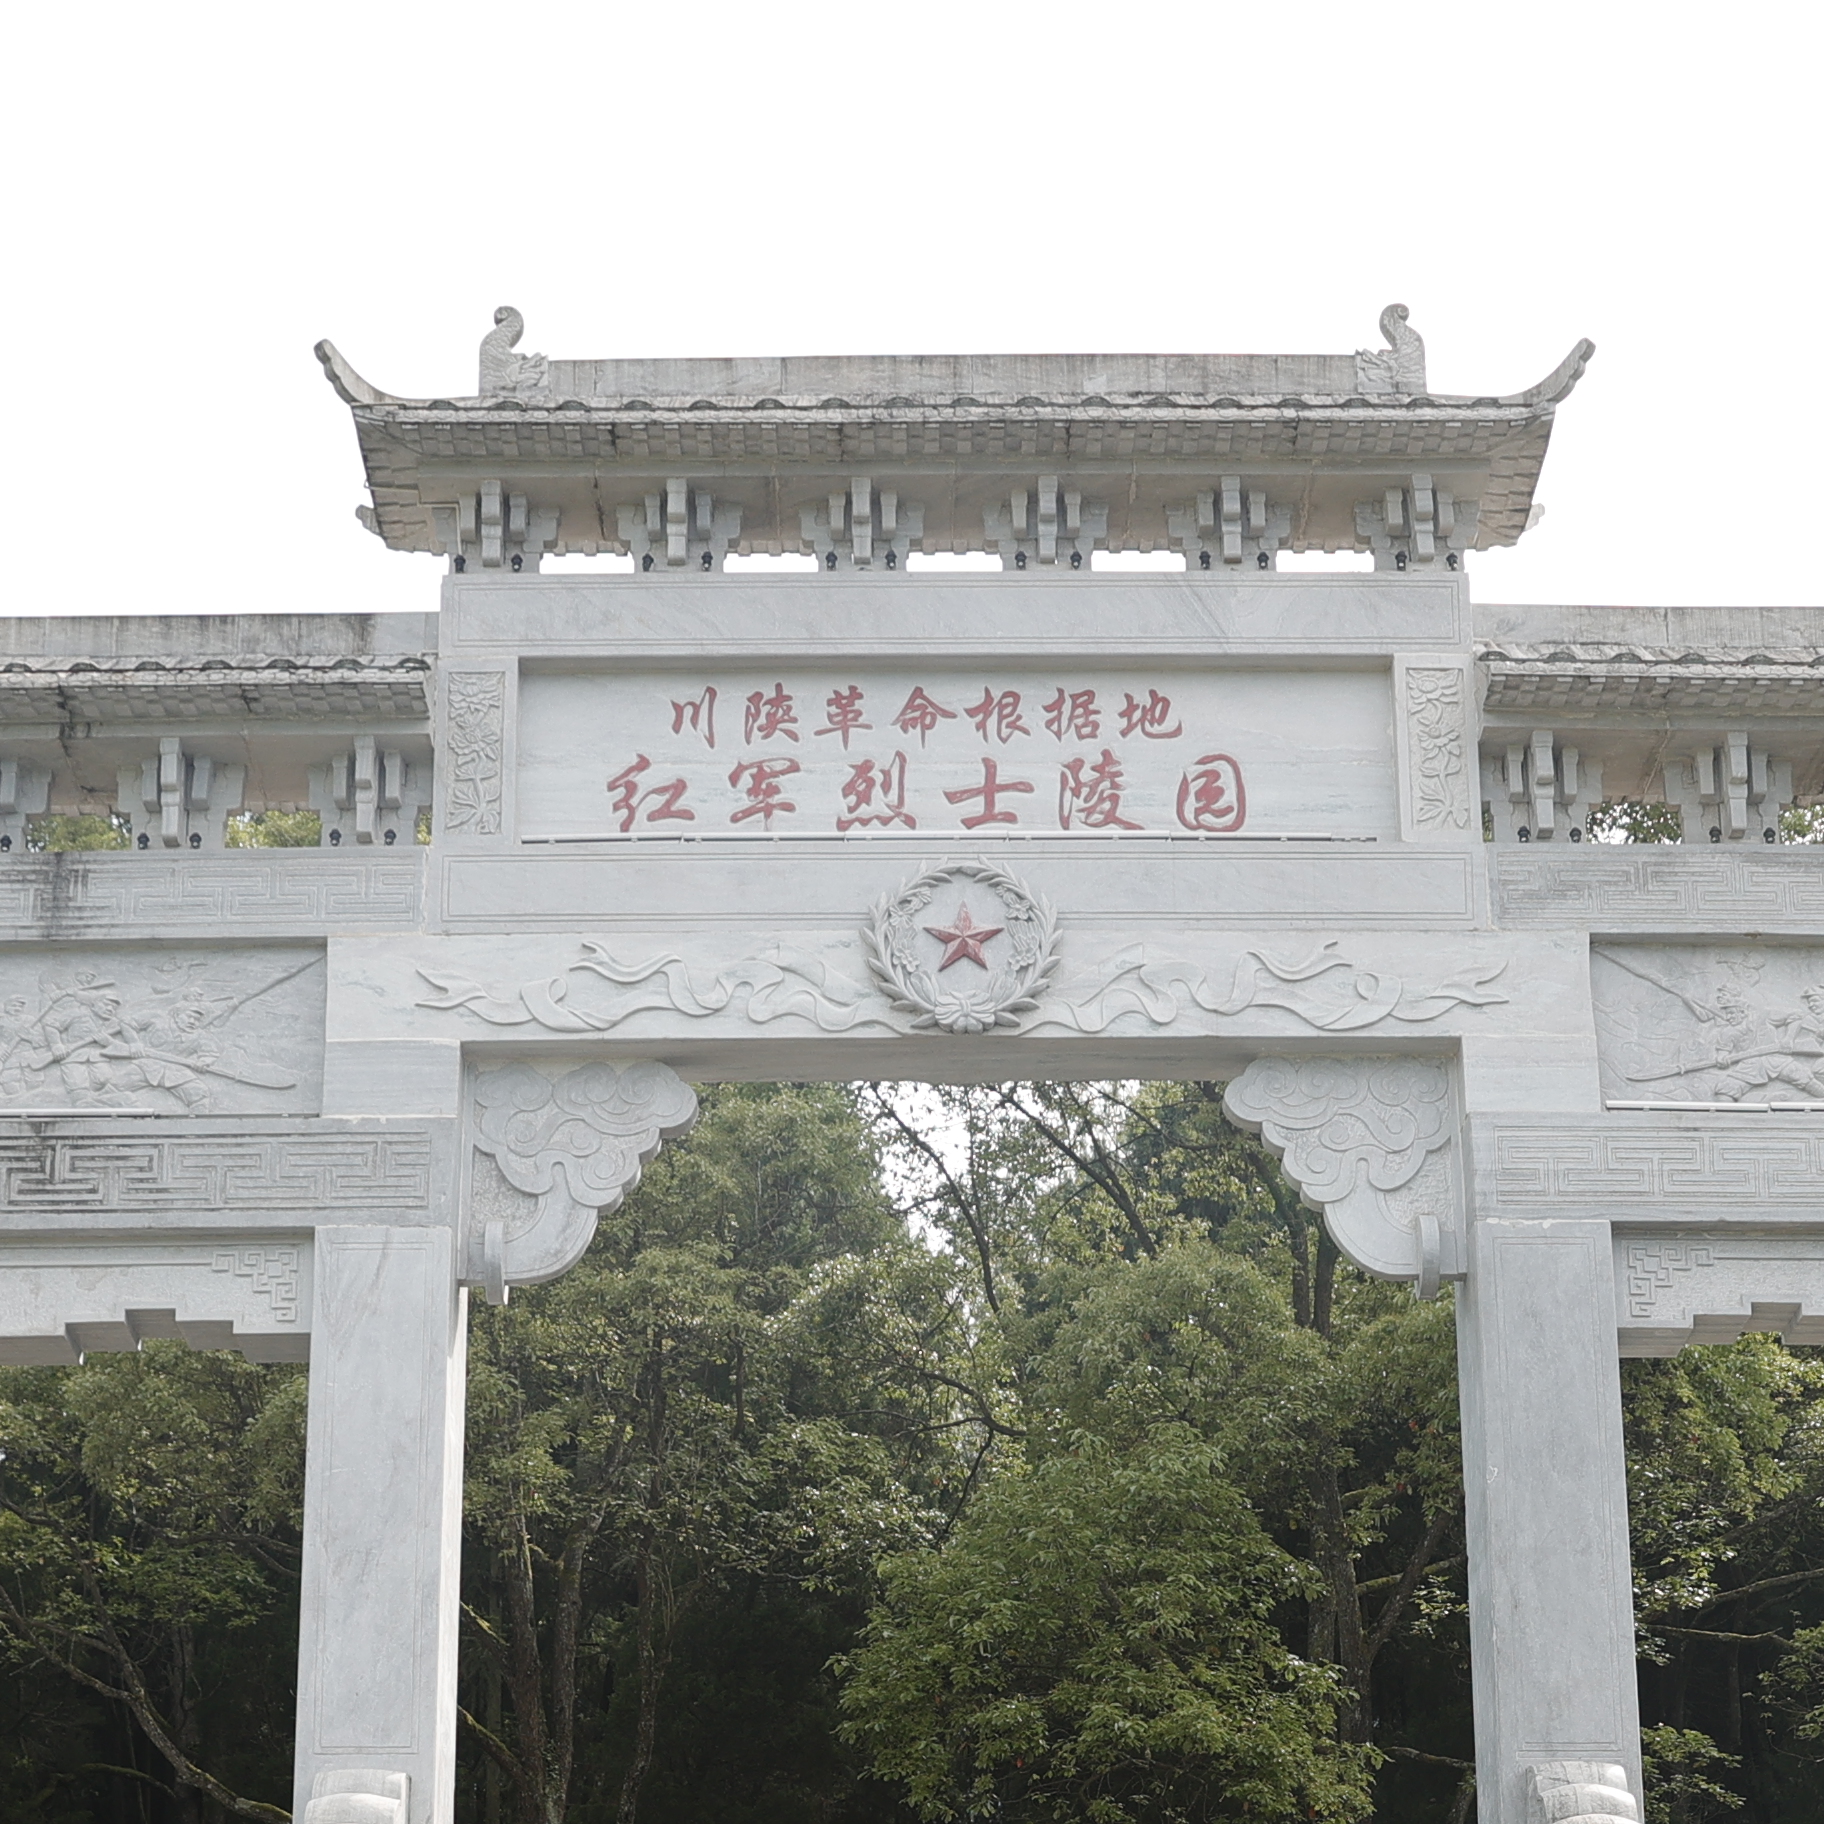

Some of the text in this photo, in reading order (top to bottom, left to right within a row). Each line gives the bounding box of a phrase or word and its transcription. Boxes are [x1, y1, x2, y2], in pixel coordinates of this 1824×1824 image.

[605, 750, 1247, 834] 红军烈士陵园
